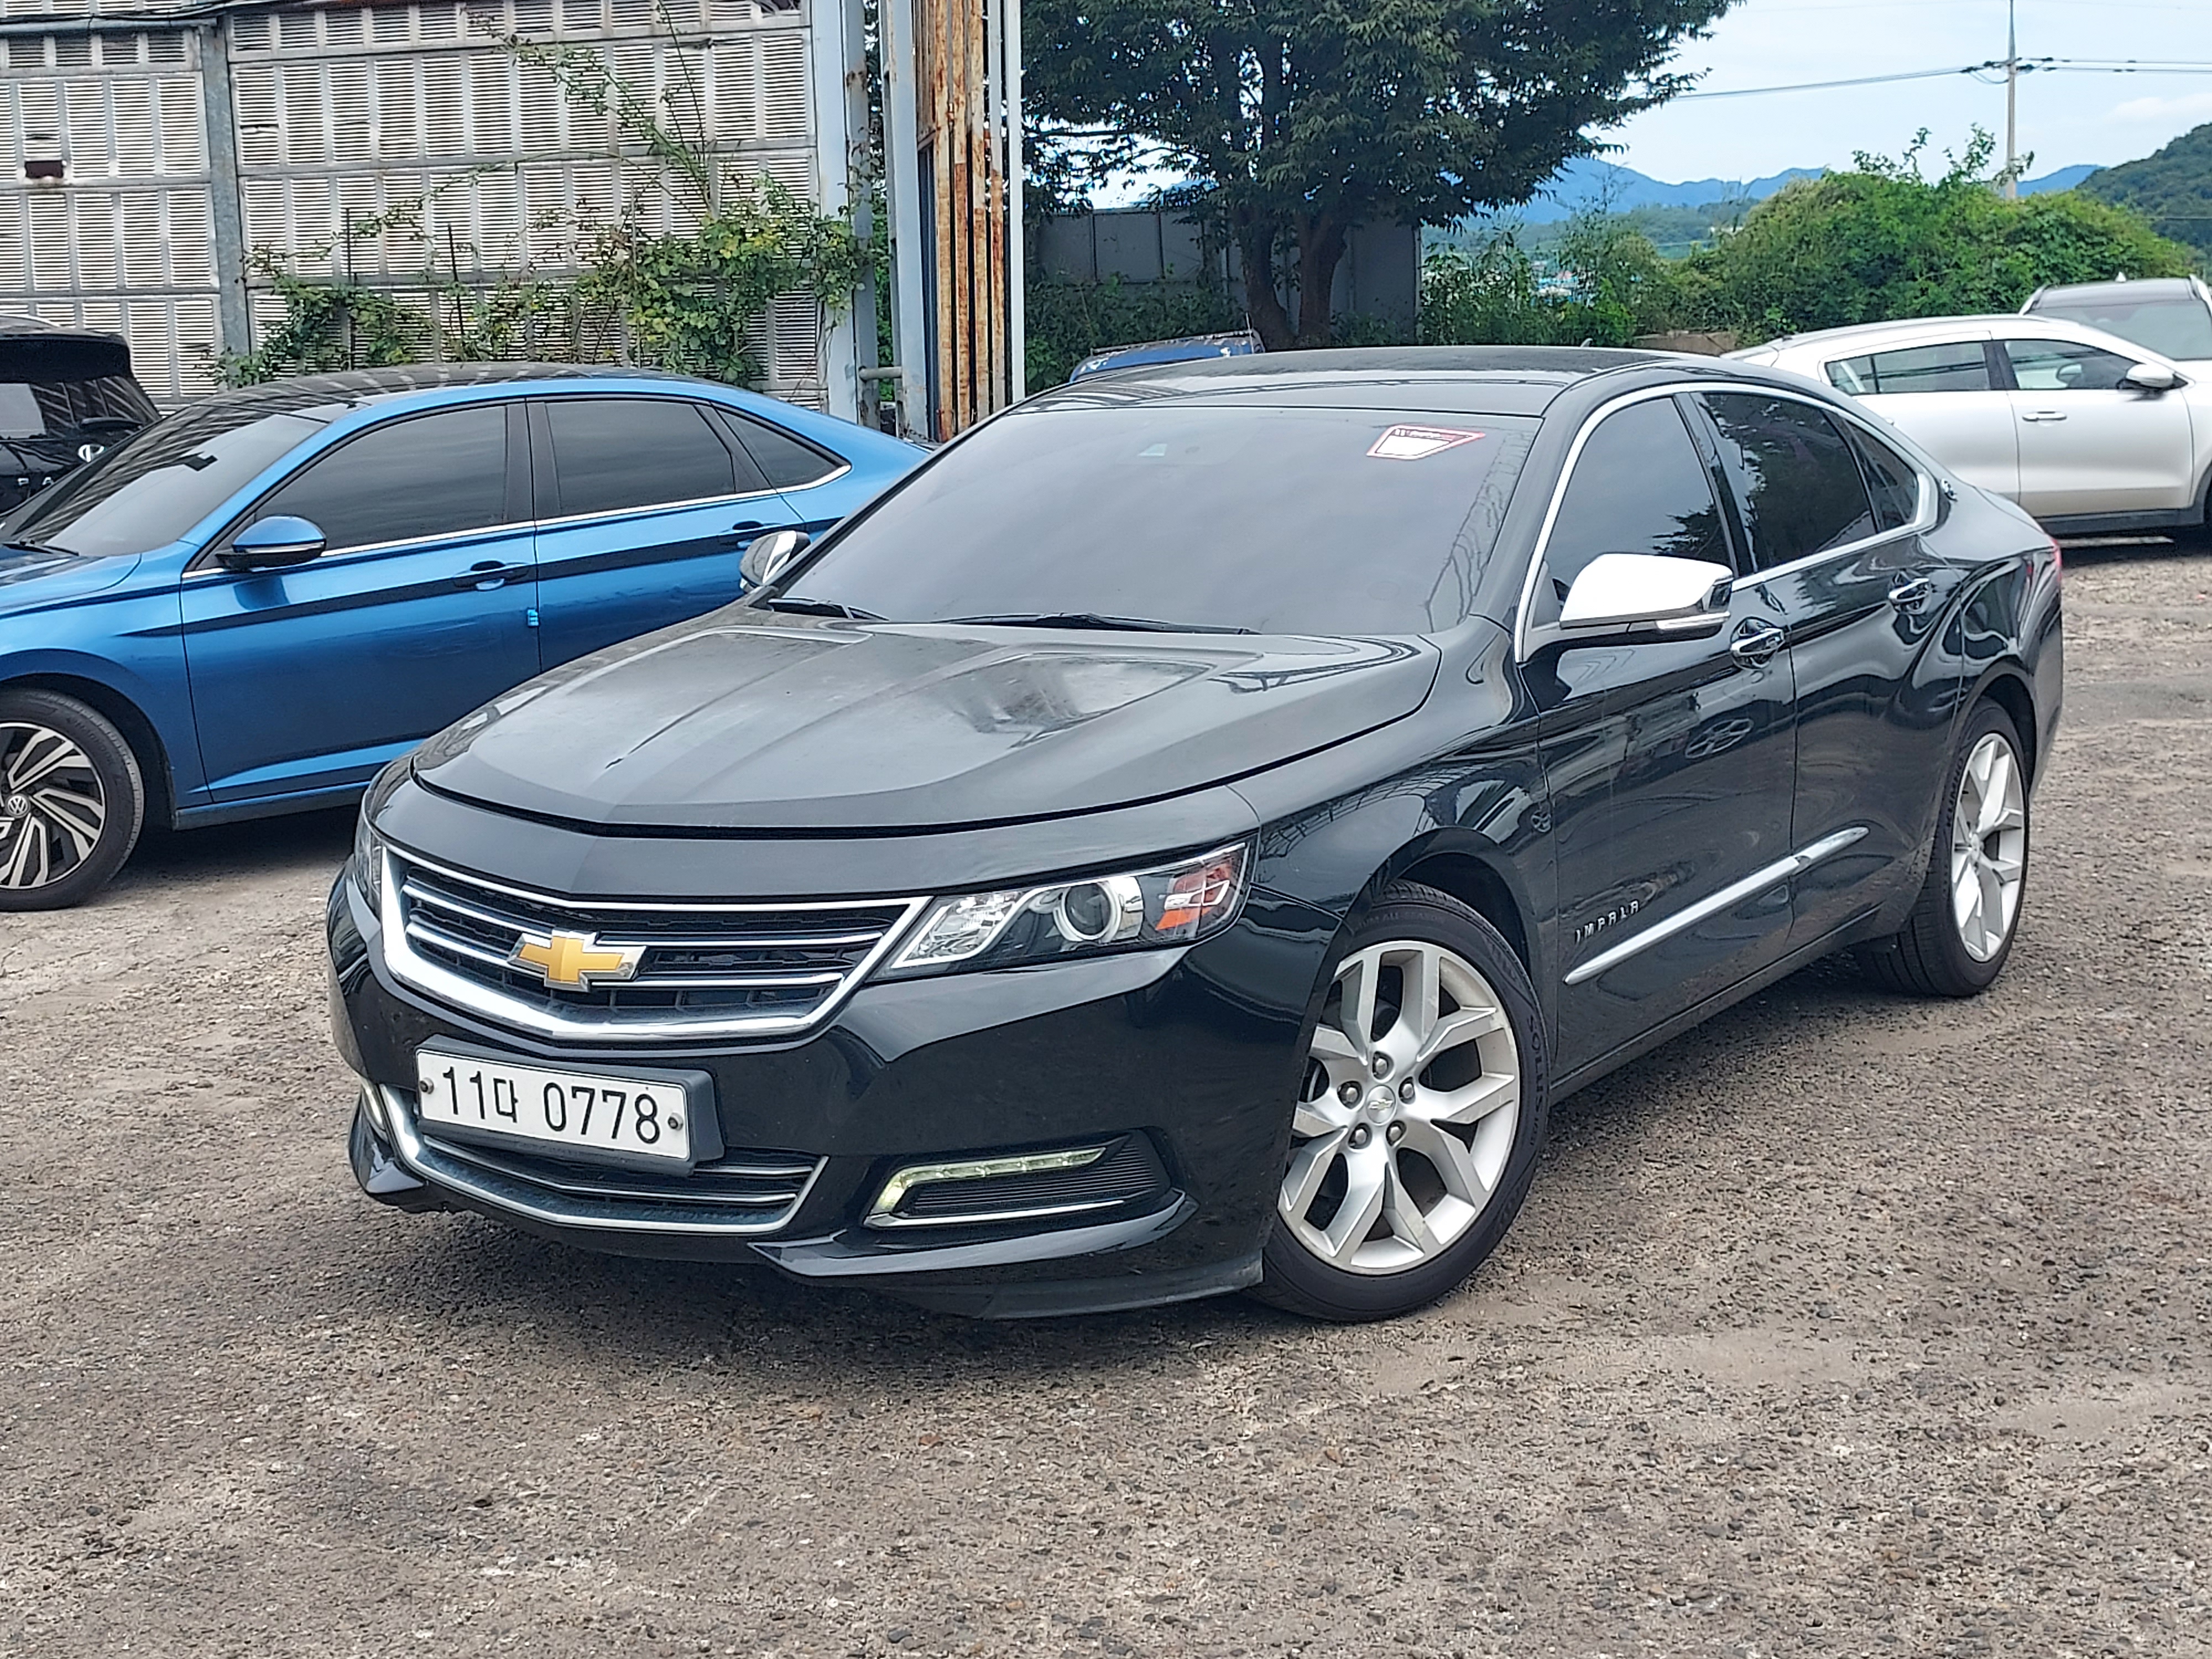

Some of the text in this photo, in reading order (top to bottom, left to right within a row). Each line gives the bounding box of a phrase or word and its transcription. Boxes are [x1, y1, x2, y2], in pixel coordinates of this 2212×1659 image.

[1575, 900, 1639, 943] IMPALA
[1527, 1014, 1544, 1113] SOLUS
[442, 1066, 661, 1144] 11다 0778
